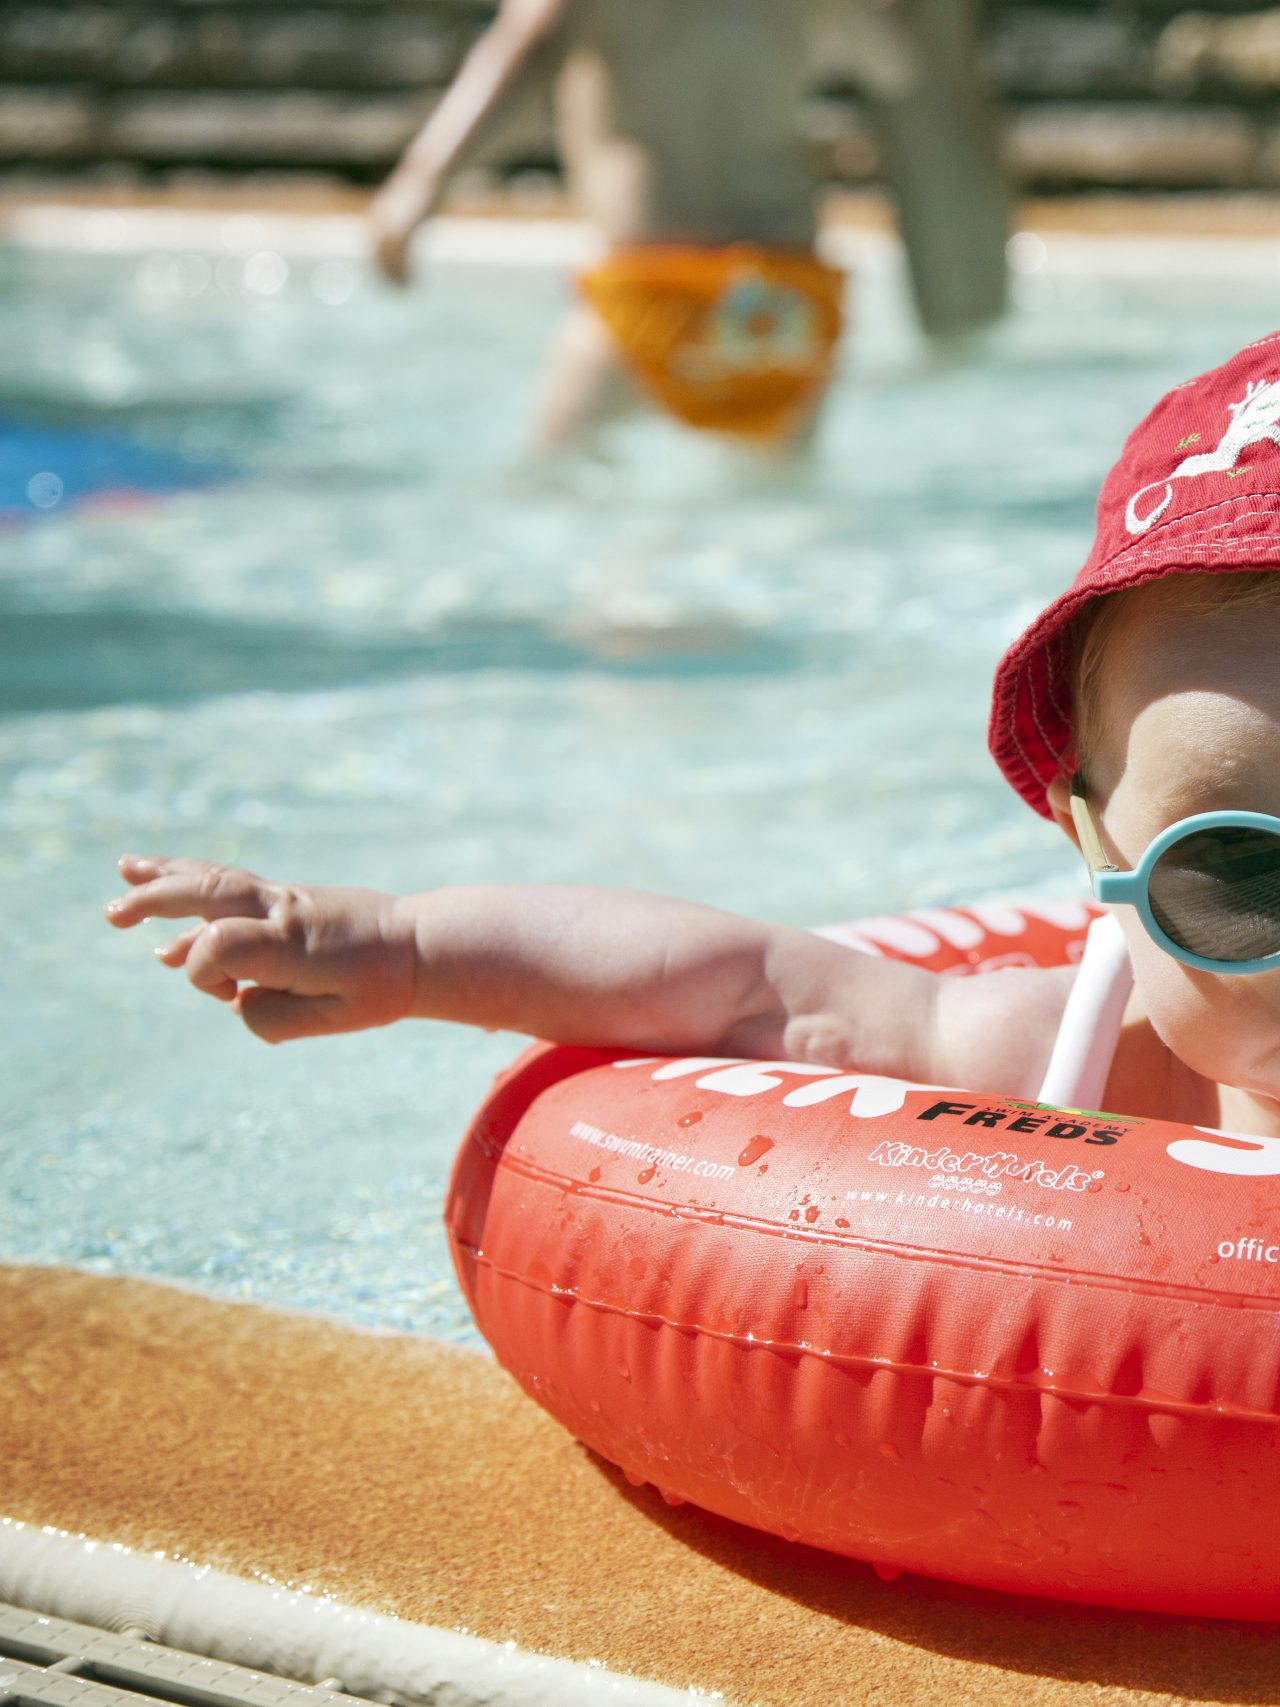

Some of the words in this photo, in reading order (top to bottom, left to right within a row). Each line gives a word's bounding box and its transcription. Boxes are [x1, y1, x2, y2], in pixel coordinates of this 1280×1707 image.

[916, 1101, 1124, 1146] FREDS
[983, 1106, 1035, 1117] SWIM
[1041, 1115, 1133, 1133] ACADEMY
[569, 1120, 736, 1181] www.swimtrainer.com
[845, 1190, 1073, 1231] www.kinderhotels.com
